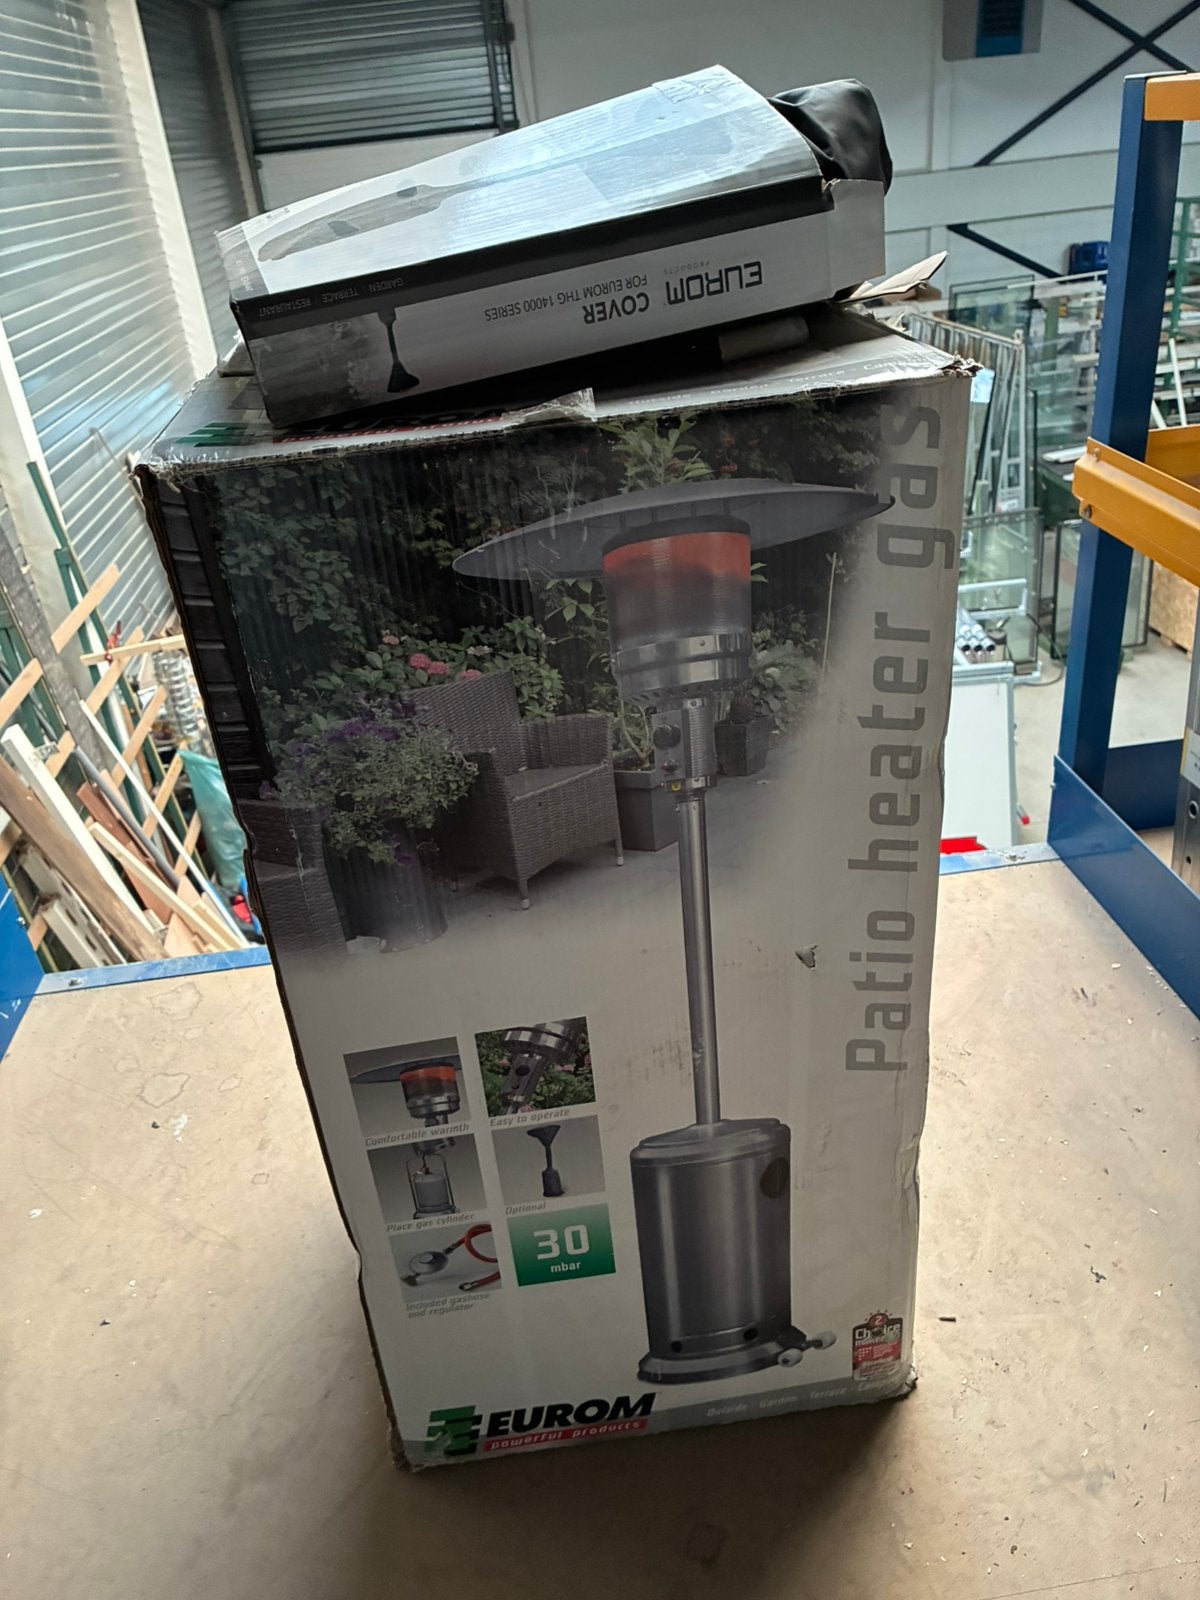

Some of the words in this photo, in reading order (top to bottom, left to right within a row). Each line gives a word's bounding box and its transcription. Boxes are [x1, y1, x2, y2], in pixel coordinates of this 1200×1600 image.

[369, 277, 404, 292] GARDEN
[584, 278, 623, 298] EUROM
[626, 274, 648, 290] FOR
[665, 261, 763, 305] EUROM
[321, 288, 359, 303] TERRACE
[523, 295, 554, 313] 14000
[557, 289, 581, 304] THG
[258, 297, 312, 317] RESTAURANT
[484, 301, 522, 322] SERIES
[582, 291, 650, 325] COVER
[876, 403, 955, 570] gas
[847, 610, 931, 873] heater
[845, 908, 914, 1073] Patio
[490, 1116, 514, 1129] Easy
[517, 1113, 527, 1123] to
[530, 1108, 570, 1124] operate
[365, 1128, 428, 1147] Comfortable
[430, 1122, 470, 1138] warmth
[505, 1202, 546, 1215] Optional
[386, 1222, 413, 1233] Place
[416, 1219, 433, 1231] gas
[436, 1212, 474, 1227] cylinder
[533, 1224, 590, 1260] 30
[550, 1261, 581, 1273] mbar
[408, 1309, 426, 1319] and
[428, 1303, 473, 1316] regulator
[855, 1324, 901, 1340] Chice
[487, 1392, 657, 1438] EUROM
[491, 1431, 562, 1450] powerful
[572, 1420, 641, 1439] products
